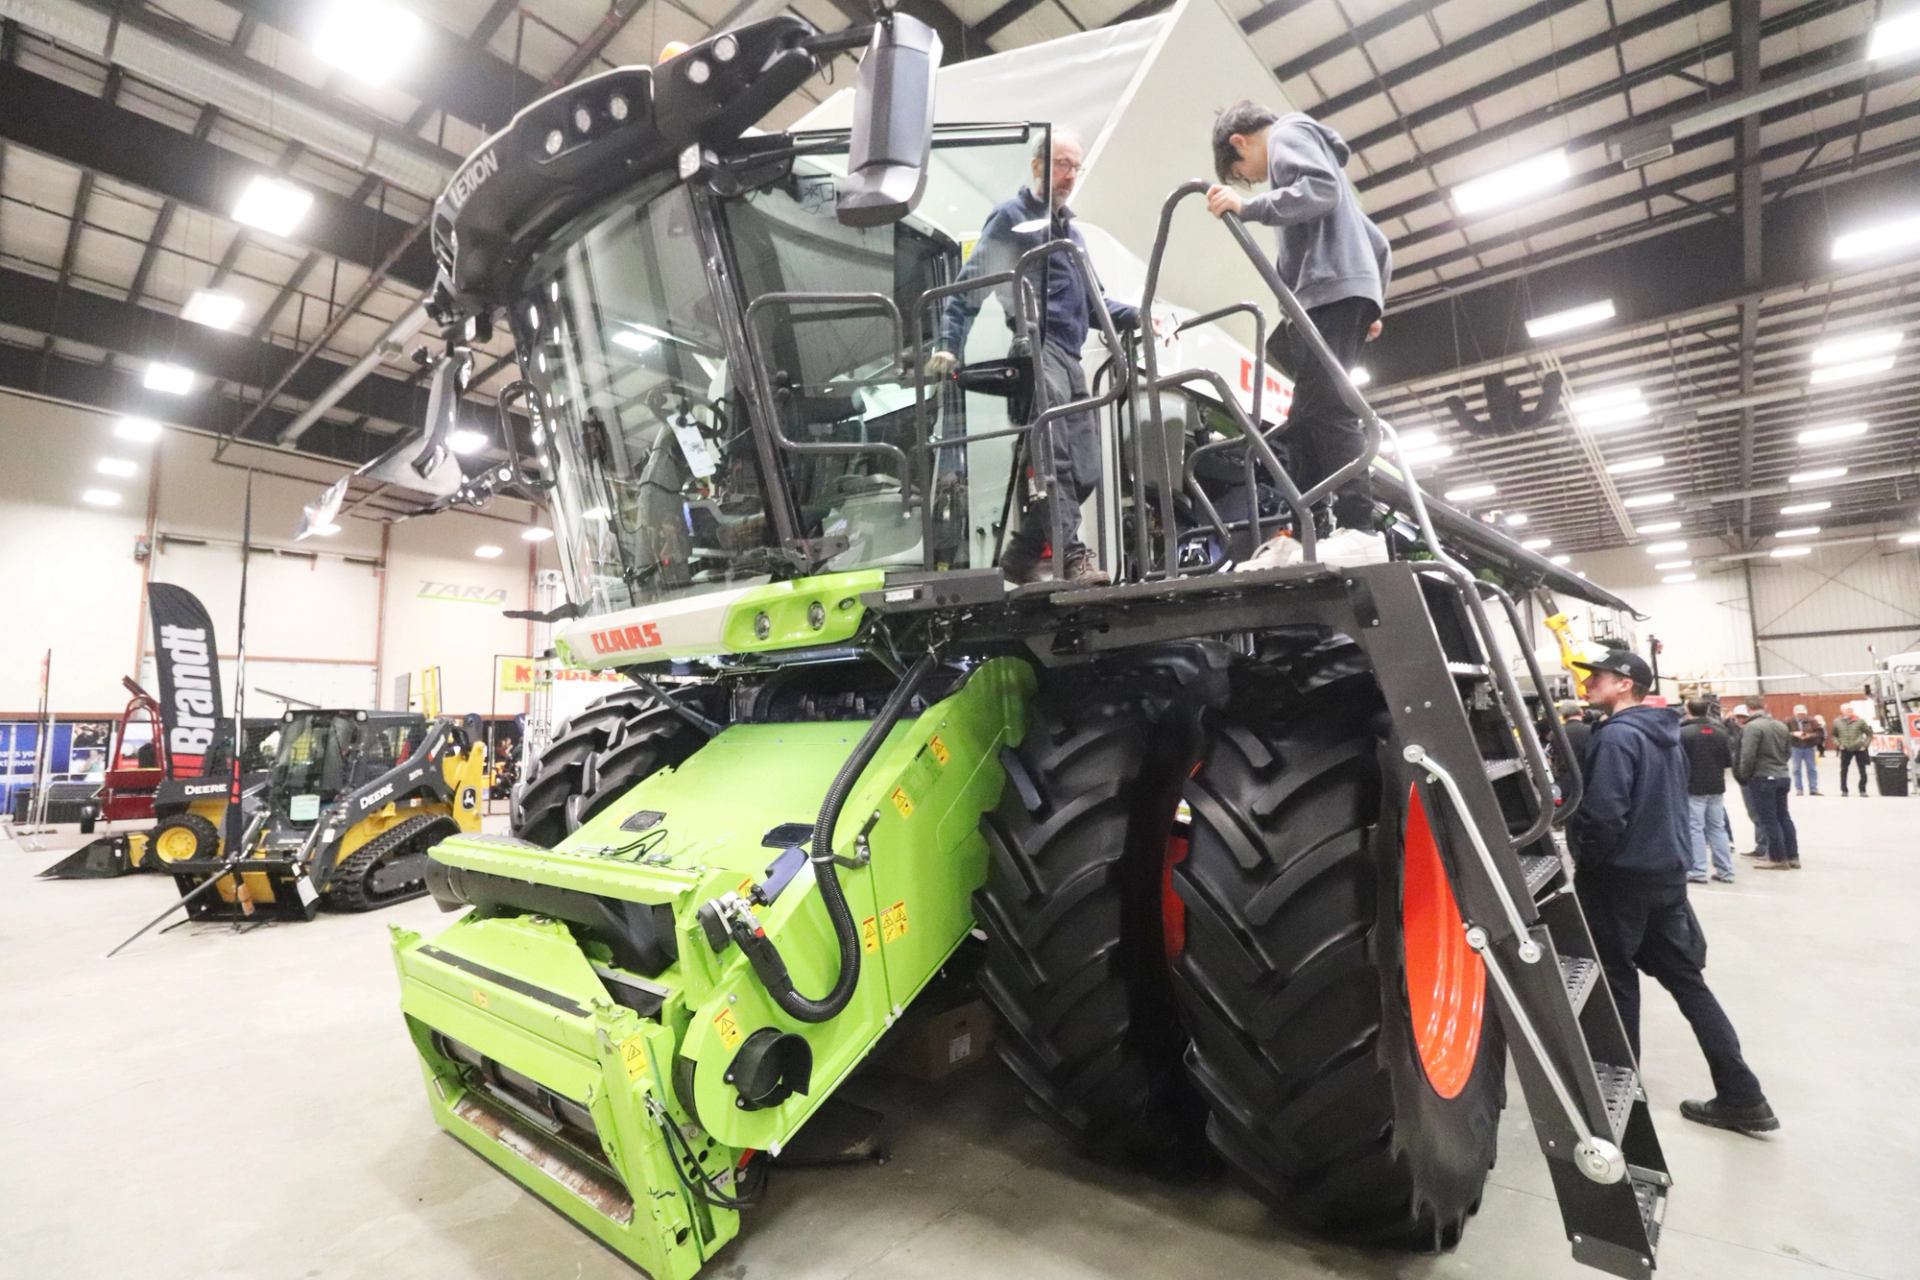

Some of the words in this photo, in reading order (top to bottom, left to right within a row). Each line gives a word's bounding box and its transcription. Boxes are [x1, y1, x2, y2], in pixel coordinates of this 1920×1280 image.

[448, 149, 499, 209] LEXION
[418, 579, 507, 602] TARA
[591, 622, 662, 655] CLAAS
[160, 624, 216, 755] Brandt
[184, 783, 228, 796] DEERE
[359, 782, 394, 810] DEERE
